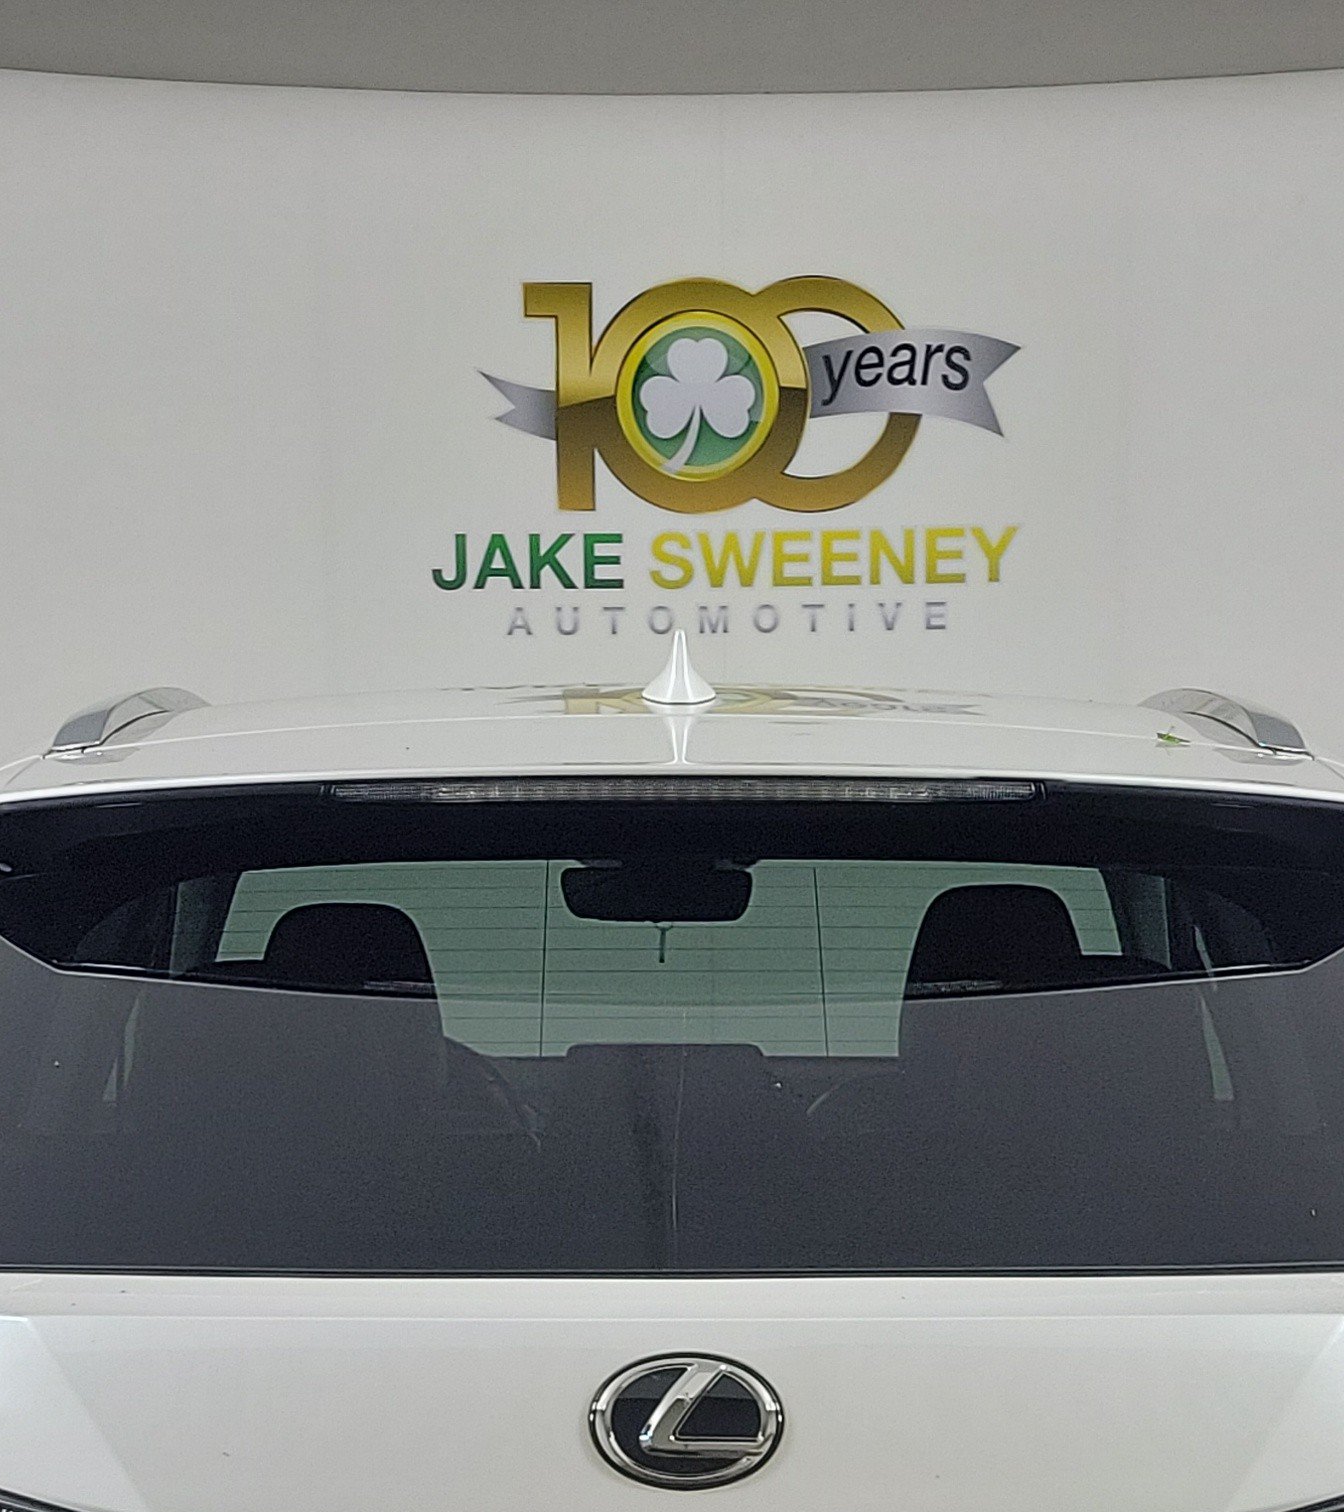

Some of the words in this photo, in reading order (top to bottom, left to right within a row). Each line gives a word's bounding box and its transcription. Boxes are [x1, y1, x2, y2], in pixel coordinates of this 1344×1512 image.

[820, 342, 973, 405] years
[432, 533, 625, 590] JAKE
[648, 526, 1019, 588] SWEENEY
[507, 602, 948, 636] AUTOMOTIVE
